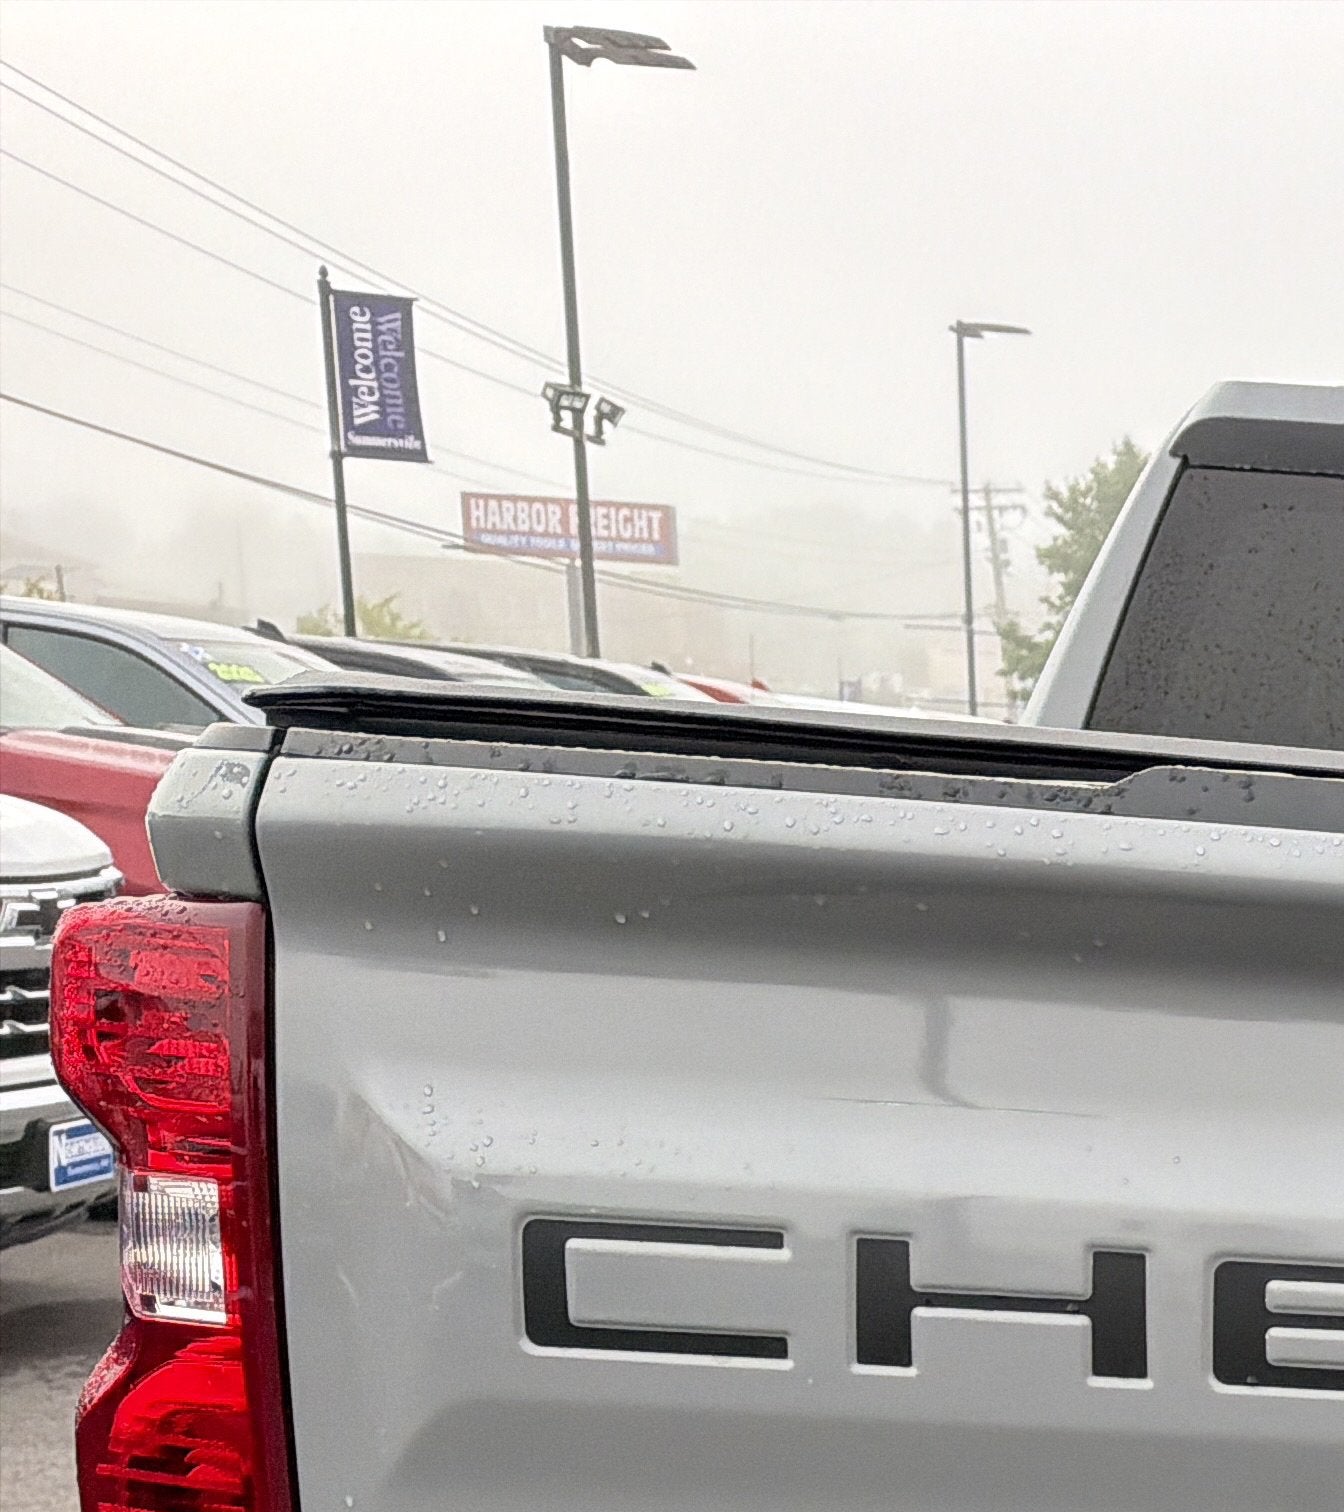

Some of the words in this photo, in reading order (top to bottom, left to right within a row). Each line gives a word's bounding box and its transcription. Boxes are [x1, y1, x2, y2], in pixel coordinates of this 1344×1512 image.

[348, 305, 381, 426] Welcome
[376, 312, 406, 431] Welcome
[470, 497, 563, 534] HARBOR
[568, 504, 662, 541] FEIGHT
